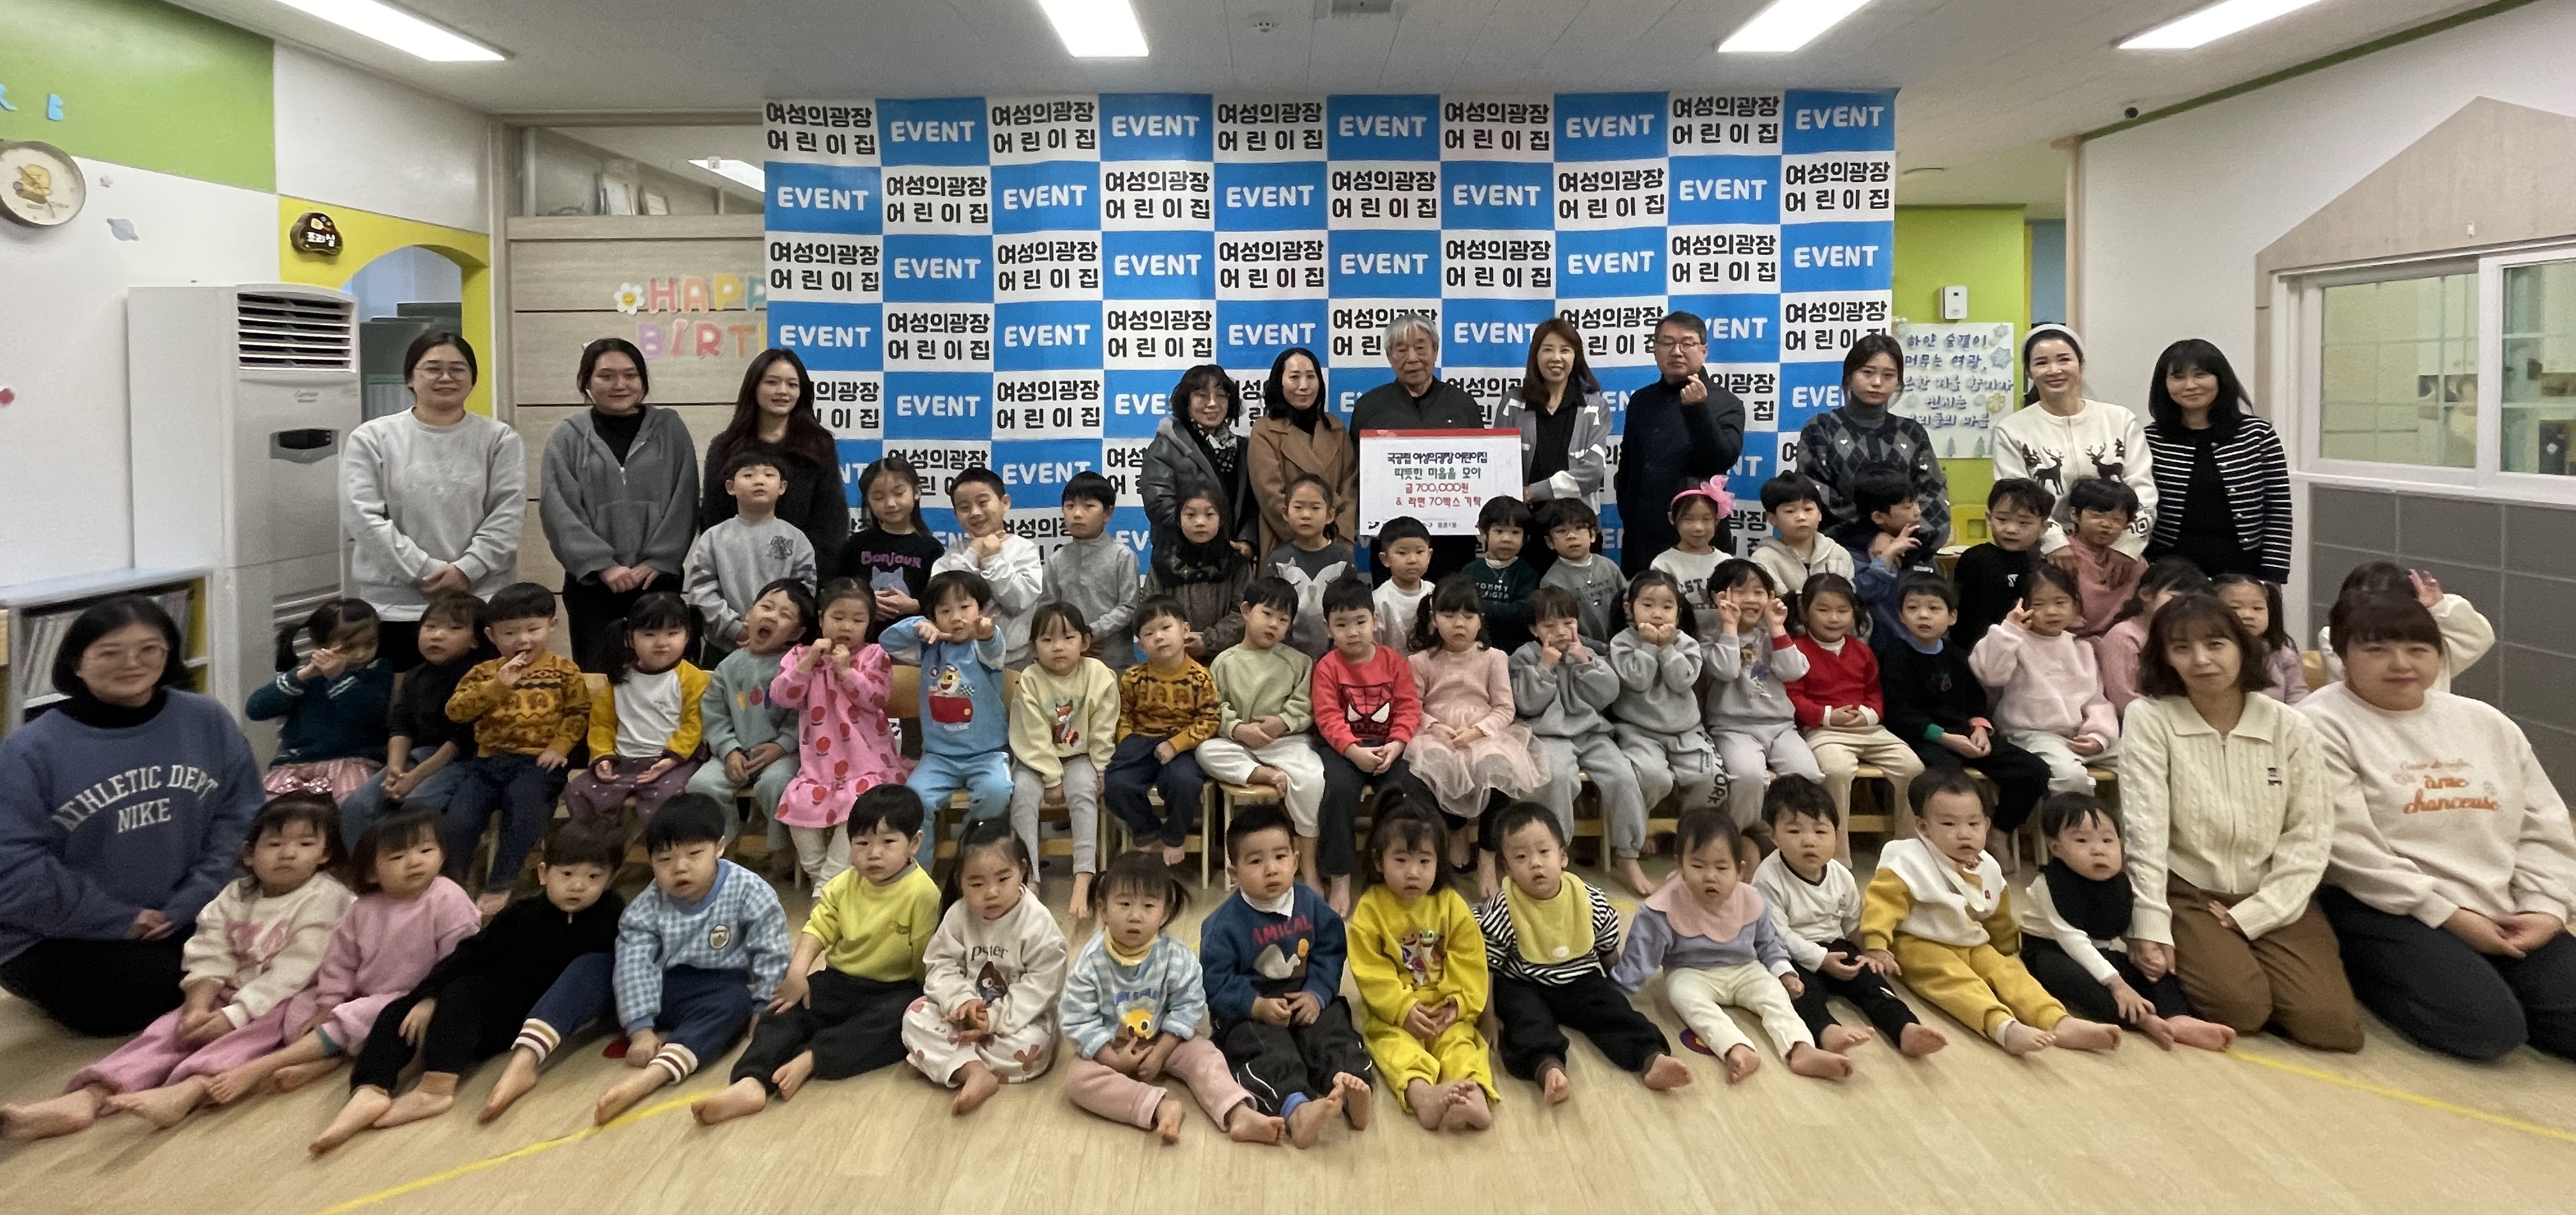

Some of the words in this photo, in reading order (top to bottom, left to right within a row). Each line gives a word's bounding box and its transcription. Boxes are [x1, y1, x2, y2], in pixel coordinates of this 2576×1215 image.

[766, 102, 872, 128] 여성의광장
[992, 101, 1094, 126] 여성의광장
[1218, 100, 1324, 125] 여성의광장
[1445, 99, 1549, 124] 여성의광장
[1673, 96, 1780, 118] 여성의광장
[1796, 106, 1883, 130] EVENT
[891, 121, 975, 142] EVENT
[1112, 115, 1199, 137] EVENT
[1340, 116, 1426, 137] EVENT
[1567, 114, 1654, 137] EVENT
[1106, 171, 1209, 192] 여성의광장
[1332, 171, 1436, 191] 여성의광장
[1559, 168, 1664, 192] 여성의광장
[1786, 162, 1890, 185] 여성의광장
[887, 176, 986, 197] 여성의광장
[1004, 185, 1087, 210] EVENT
[1227, 186, 1314, 207] EVENT
[1453, 185, 1540, 206] EVENT
[1680, 179, 1767, 201] EVENT
[778, 187, 869, 210] EVENT
[770, 242, 879, 265] 여성의광장
[998, 241, 1097, 264] 여성의광장
[1220, 240, 1324, 262] 여성의광장
[1446, 240, 1551, 260] 여성의광장
[1673, 234, 1775, 255] 여성의광장
[1114, 255, 1201, 275] EVENT
[1340, 253, 1428, 274] EVENT
[1568, 251, 1654, 274] EVENT
[1794, 246, 1878, 268] EVENT
[894, 258, 981, 279] EVENT
[648, 273, 767, 314] HAPP
[888, 313, 990, 333] 여성의광장
[1108, 310, 1211, 330] 여성의광장
[1786, 301, 1887, 323] 여성의광장
[780, 325, 870, 347] EVENT
[1004, 325, 1090, 346] EVENT
[1229, 323, 1315, 345] EVENT
[1705, 317, 1768, 340] ENT
[1905, 353, 1942, 368] 머무는
[815, 381, 880, 402] 의광장
[998, 380, 1100, 402] 여성의광장
[1710, 373, 1775, 394] 의광장
[897, 395, 980, 416] EVENT
[1115, 394, 1169, 415] EVE
[1792, 385, 1846, 408] EVE
[1454, 452, 1488, 464] 어린이집
[1462, 467, 1481, 480] 모아
[1416, 482, 1469, 494] 700,000원
[1395, 496, 1402, 506] &
[1408, 496, 1425, 508] 라면
[51, 765, 162, 831] ATHLETIC
[167, 764, 218, 800] DEPT
[117, 798, 171, 832] NIKE
